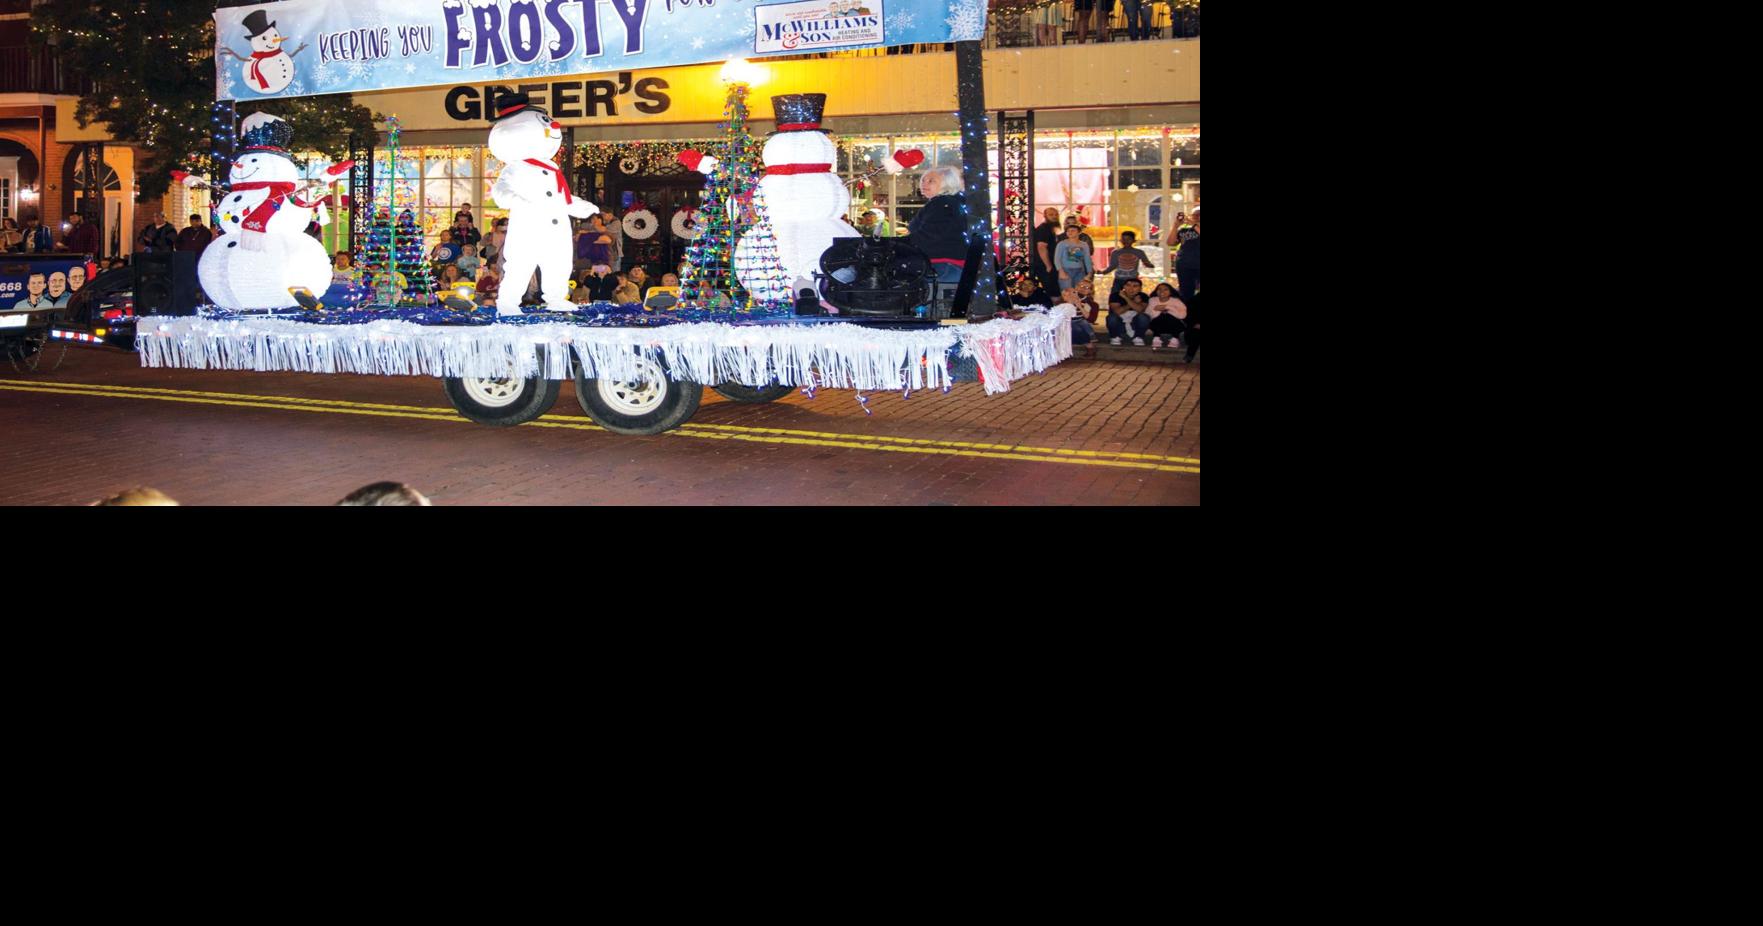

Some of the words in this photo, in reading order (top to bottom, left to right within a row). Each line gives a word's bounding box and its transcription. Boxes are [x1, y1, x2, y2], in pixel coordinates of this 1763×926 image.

[319, 27, 389, 63] KEEPING
[397, 25, 431, 56] YOU
[443, 0, 650, 67] FROSTY
[801, 32, 831, 43] SON
